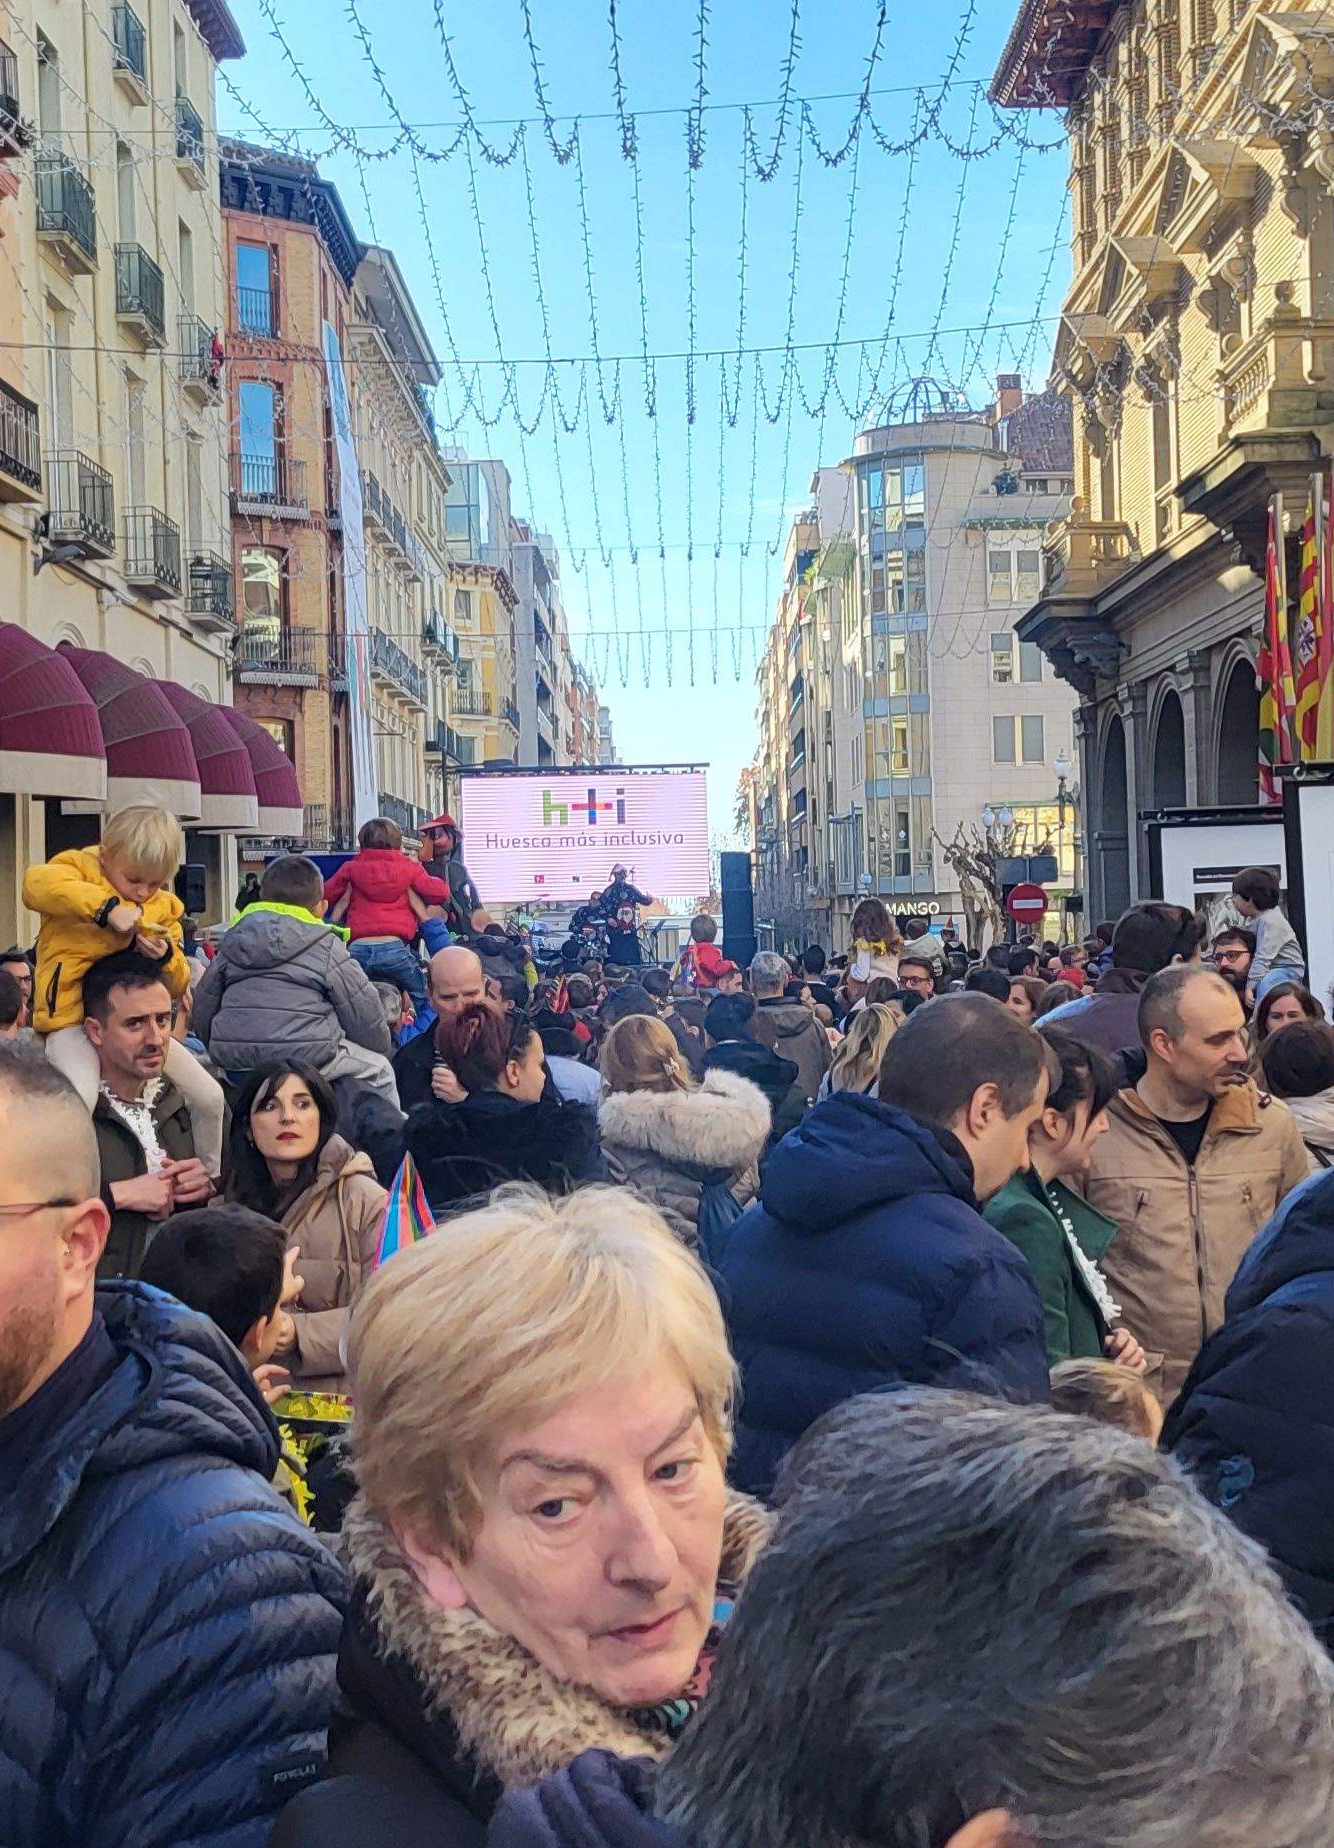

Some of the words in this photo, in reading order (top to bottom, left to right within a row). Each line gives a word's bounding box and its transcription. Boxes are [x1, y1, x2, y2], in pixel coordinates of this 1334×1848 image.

[487, 832, 551, 848] Huesca
[560, 831, 596, 847] más
[604, 830, 684, 846] inclusiva
[886, 902, 940, 916] MANGO
